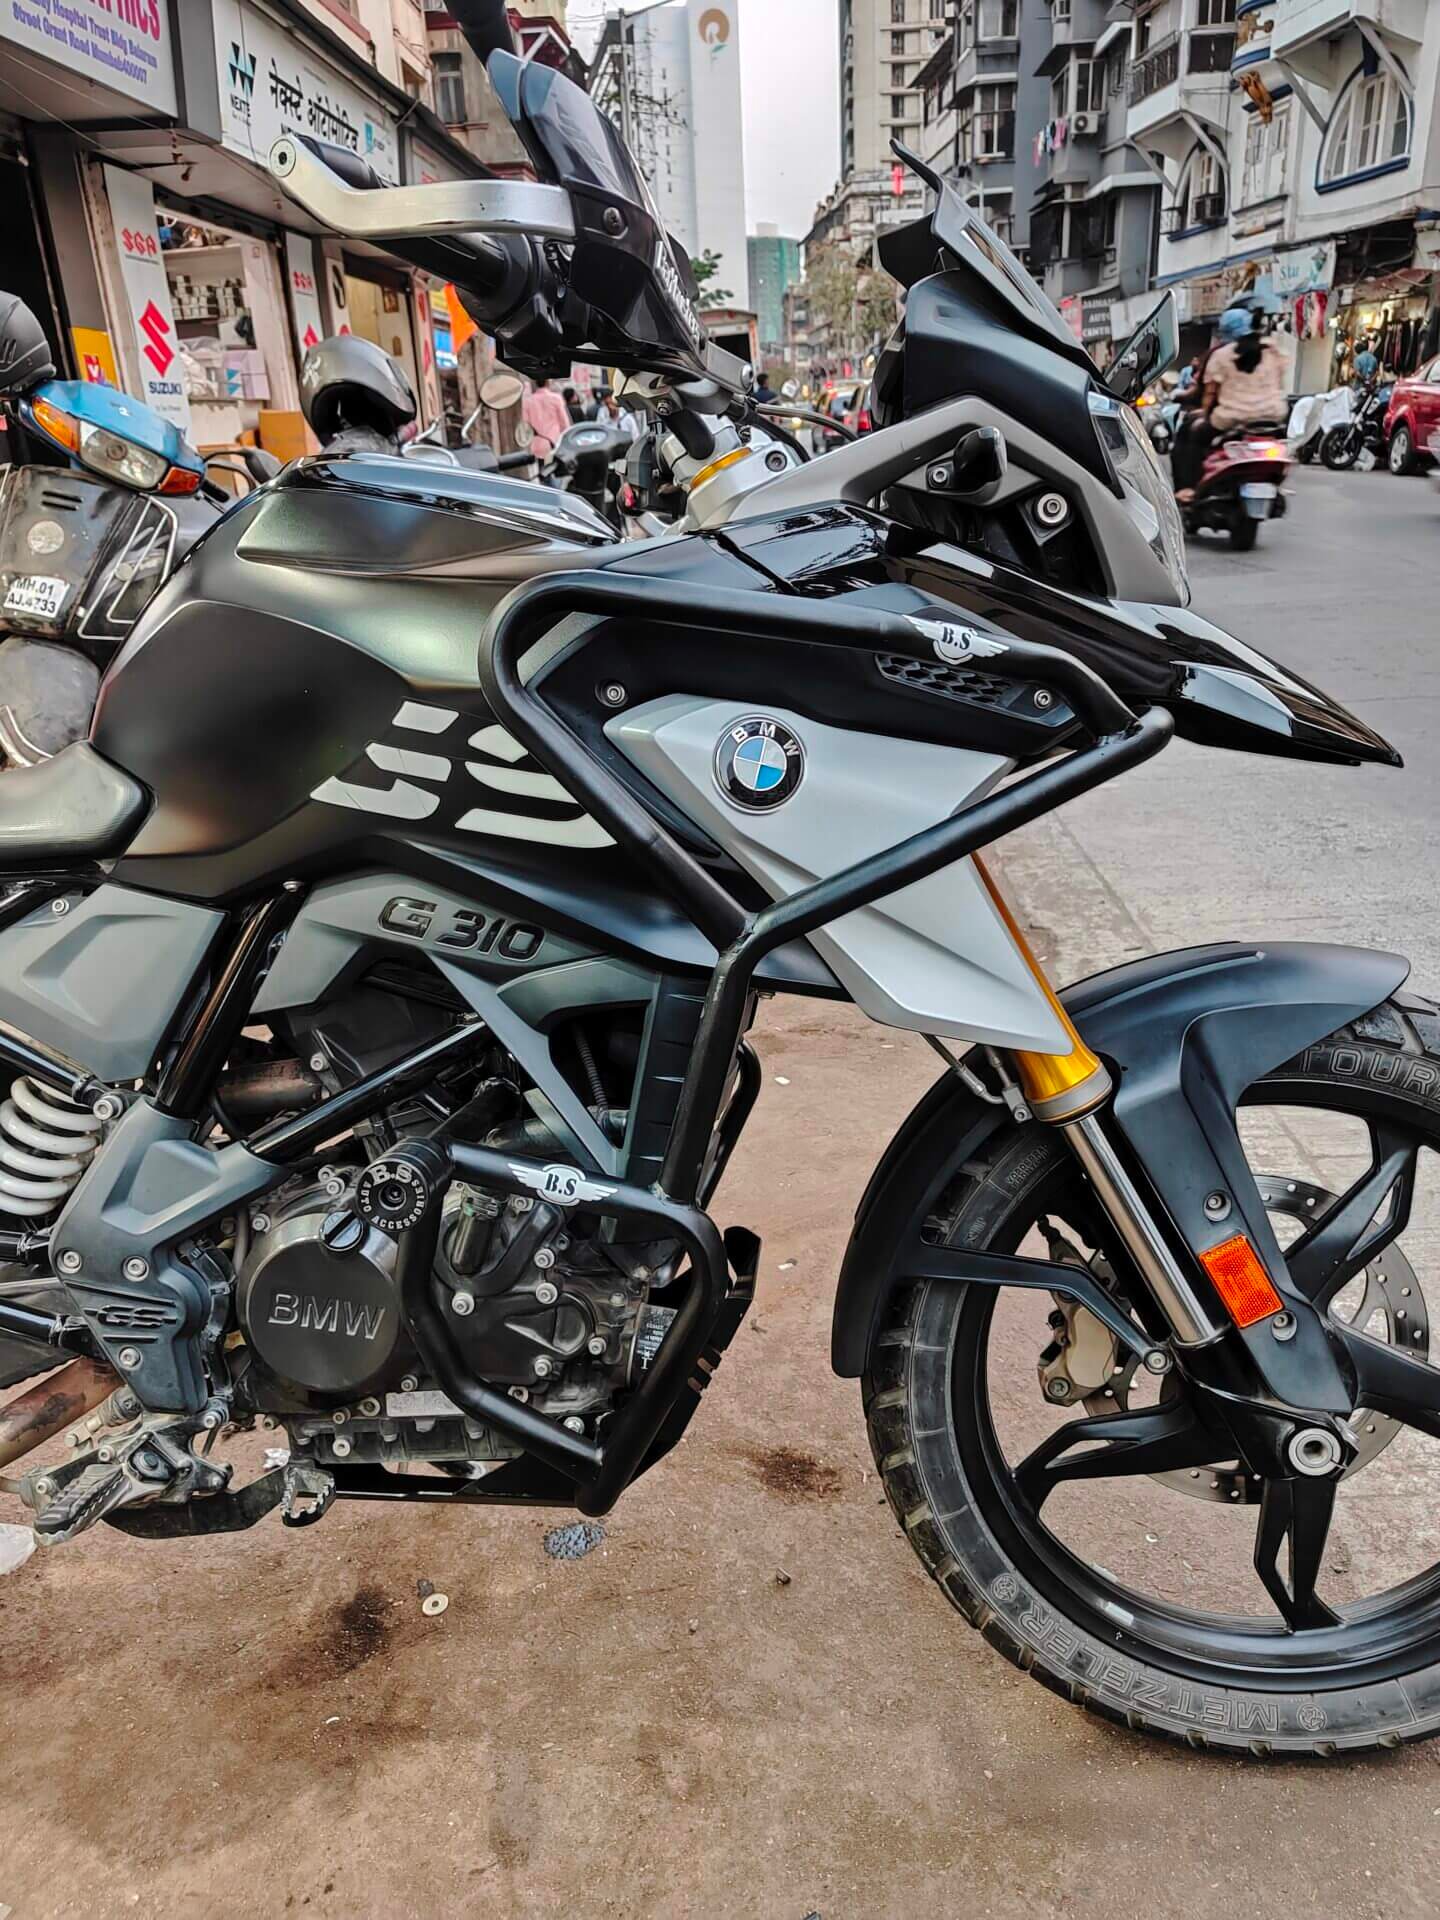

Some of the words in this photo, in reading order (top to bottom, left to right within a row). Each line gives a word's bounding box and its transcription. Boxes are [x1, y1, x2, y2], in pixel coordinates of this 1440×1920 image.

[148, 381, 183, 396] SUZUKI
[941, 626, 972, 650] B.S
[731, 722, 801, 757] BMW
[378, 896, 438, 940] G
[435, 909, 546, 962] 310
[367, 1164, 413, 1187] B.S
[544, 1173, 578, 1197] B.S
[360, 1180, 372, 1213] AUTO
[371, 1179, 425, 1230] ACCESSORIES
[267, 1293, 386, 1340] BMW
[1018, 1602, 1281, 1733] METZELER
